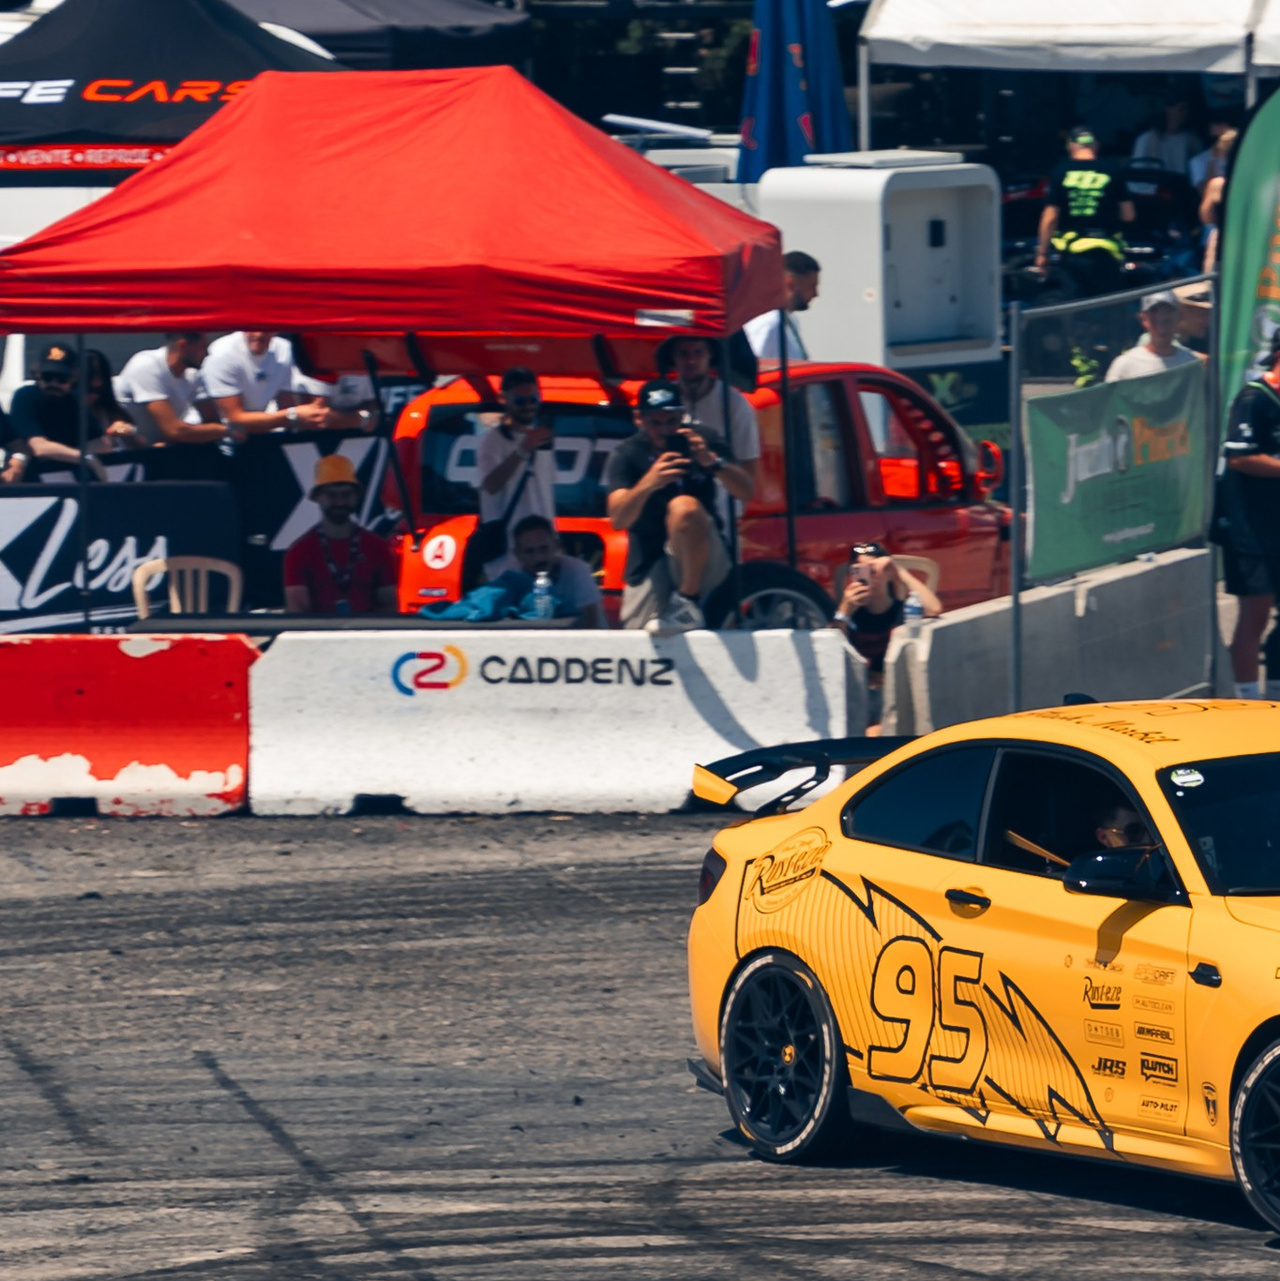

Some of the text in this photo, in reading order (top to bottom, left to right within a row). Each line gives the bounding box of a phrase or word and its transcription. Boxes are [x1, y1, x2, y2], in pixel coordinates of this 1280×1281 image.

[82, 79, 252, 102] CARS
[480, 655, 675, 686] CADDENZ
[867, 934, 988, 1094] 95
